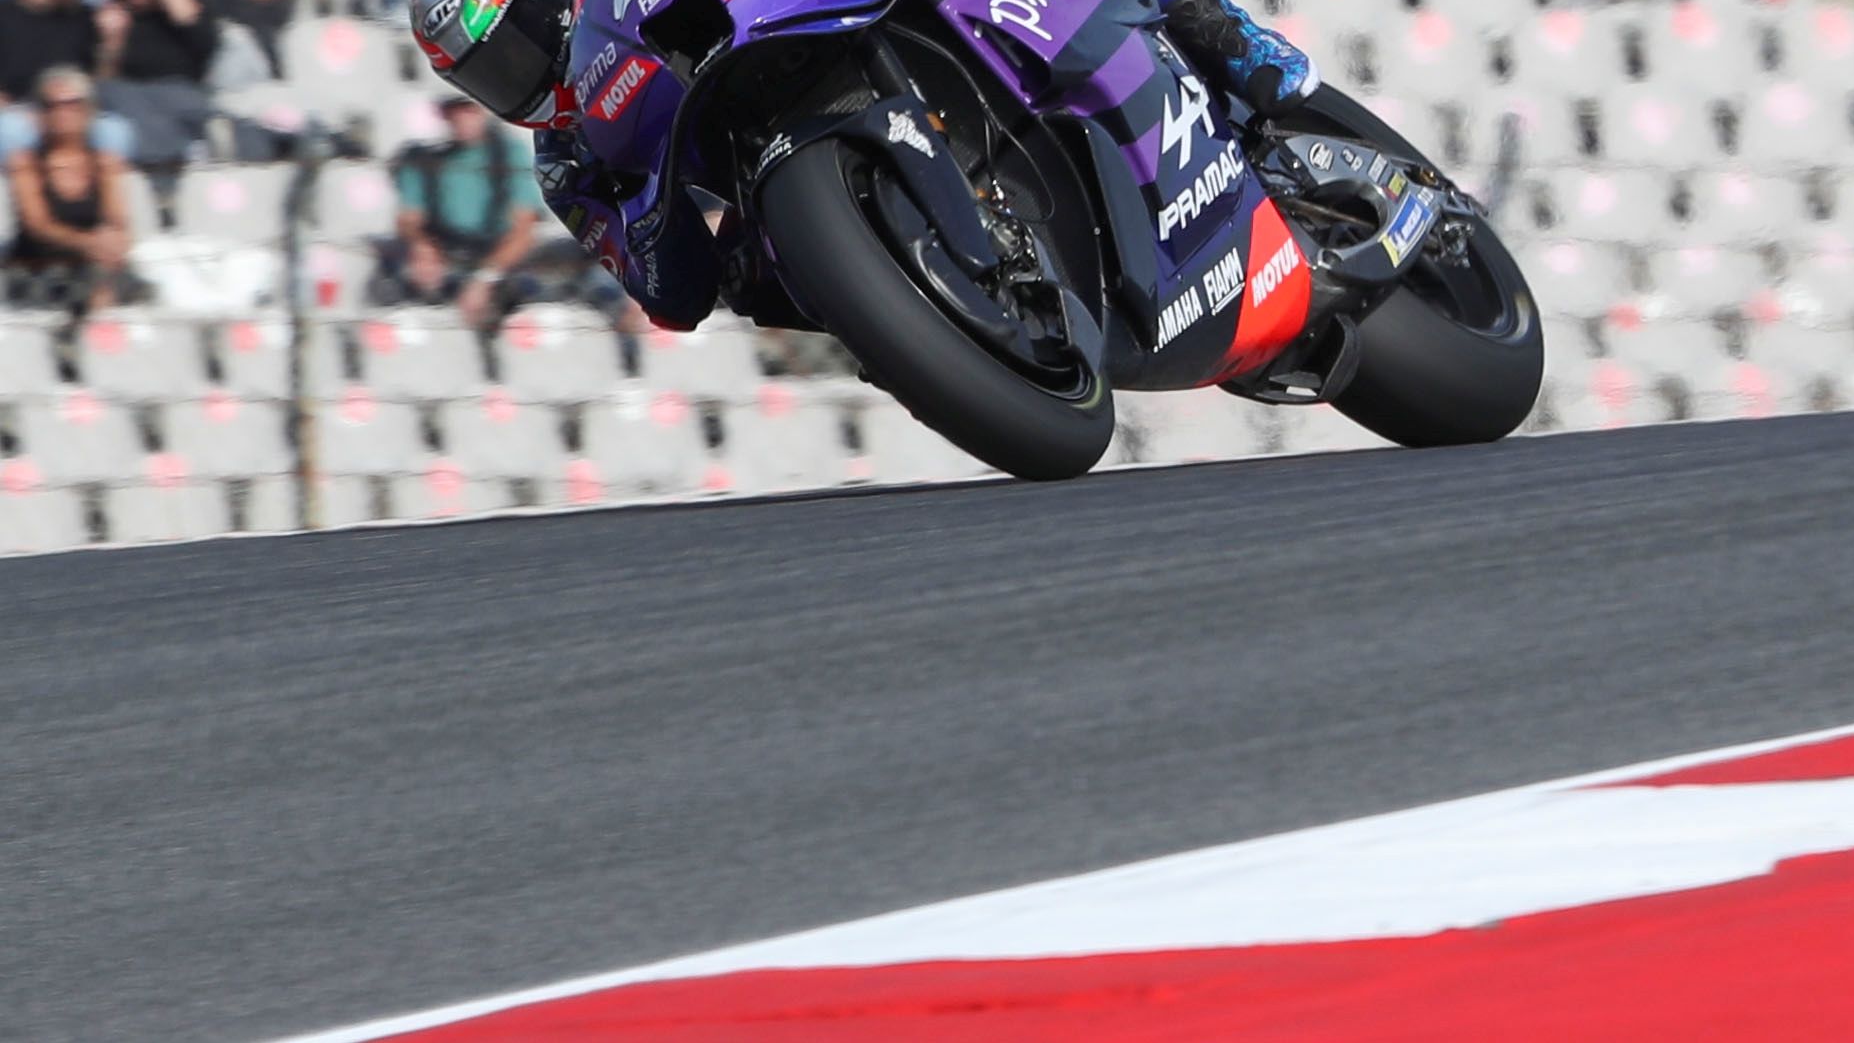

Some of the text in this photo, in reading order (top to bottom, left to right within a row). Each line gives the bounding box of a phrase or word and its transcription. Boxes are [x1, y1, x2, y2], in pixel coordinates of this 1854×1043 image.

[575, 41, 617, 113] prima
[600, 59, 646, 121] MOTUL
[1158, 139, 1244, 242] PRAMAC
[1154, 247, 1245, 353] AMAHA FIAMM
[1252, 237, 1300, 309] MOTUL
